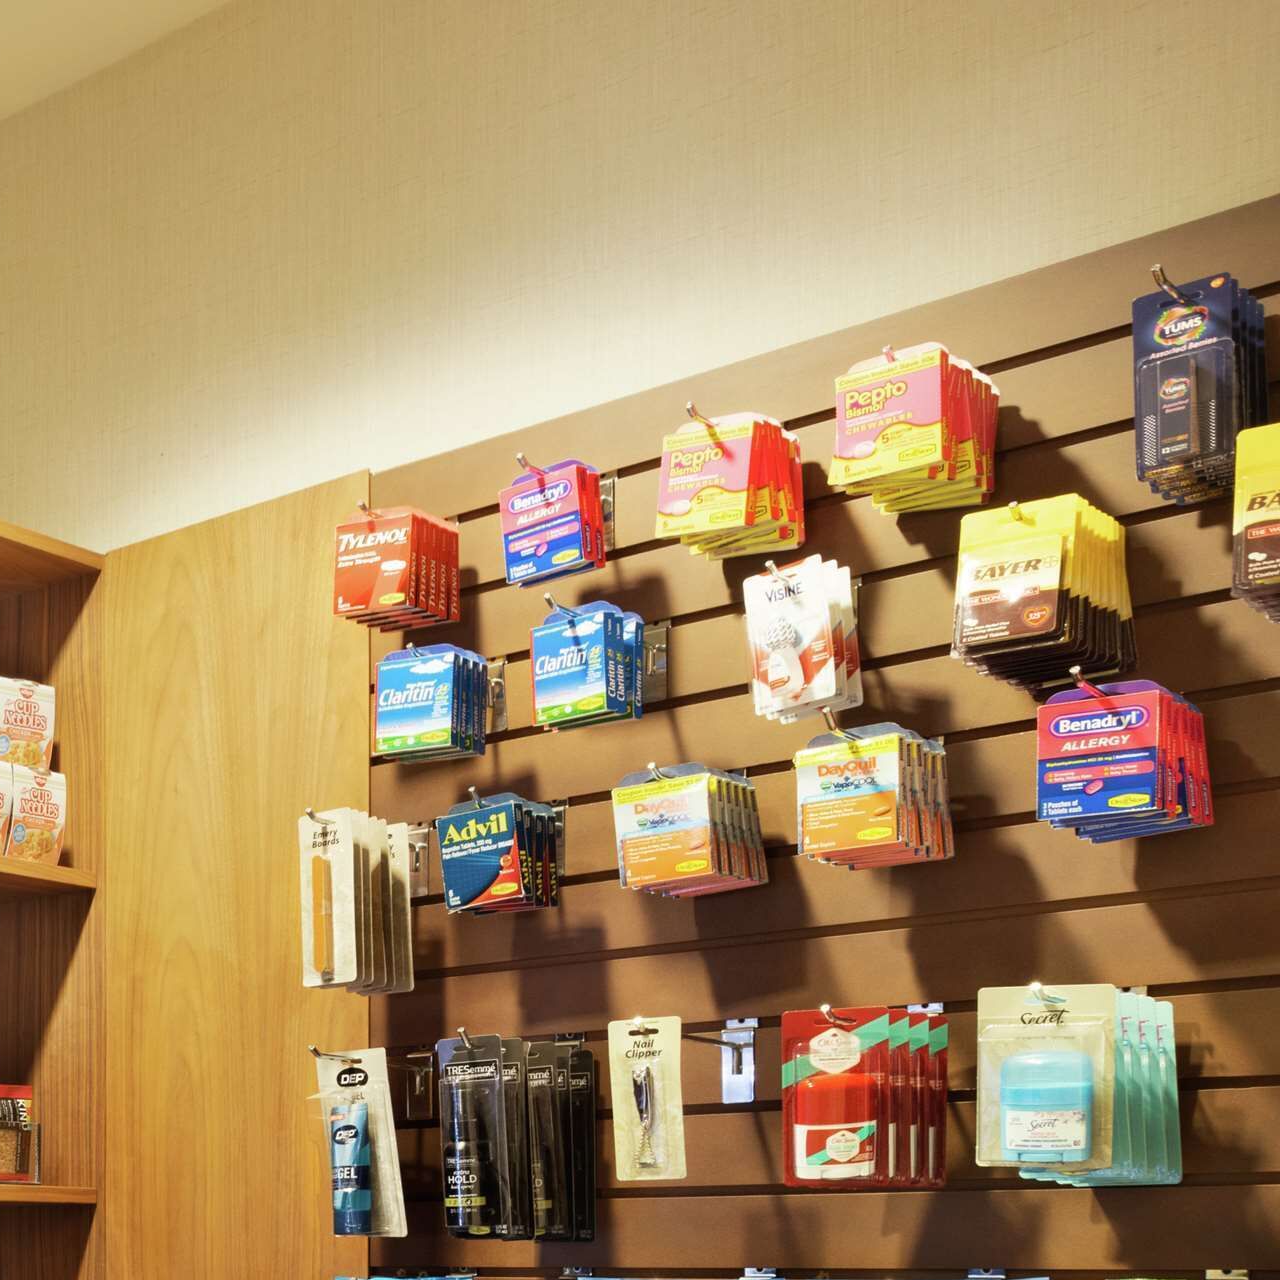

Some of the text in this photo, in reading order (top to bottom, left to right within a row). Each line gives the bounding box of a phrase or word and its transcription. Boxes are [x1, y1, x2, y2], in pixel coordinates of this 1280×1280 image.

[1163, 317, 1202, 335] TUMS
[844, 381, 907, 408] Pepto
[846, 402, 884, 419] Bismol
[669, 446, 722, 468] Pepto
[512, 483, 568, 509] Benadryl
[517, 503, 561, 526] ALLERGY
[339, 527, 409, 552] TYLENOL
[765, 583, 803, 602] VISINE
[535, 648, 587, 674] Claritin
[379, 684, 435, 706] Claritin
[1058, 711, 1138, 732] Benadryl
[1062, 734, 1130, 752] ALLERGY
[818, 758, 877, 776] DayQuil
[313, 829, 338, 840] Emery
[442, 814, 508, 844] Advil
[312, 837, 341, 849] Boards
[624, 1047, 662, 1059] Clipper
[632, 1039, 654, 1049] Nail
[446, 1063, 496, 1076] TRESemmé
[339, 1073, 364, 1085] DEP
[336, 1167, 357, 1179] GEL
[447, 1174, 477, 1184] HOLD
